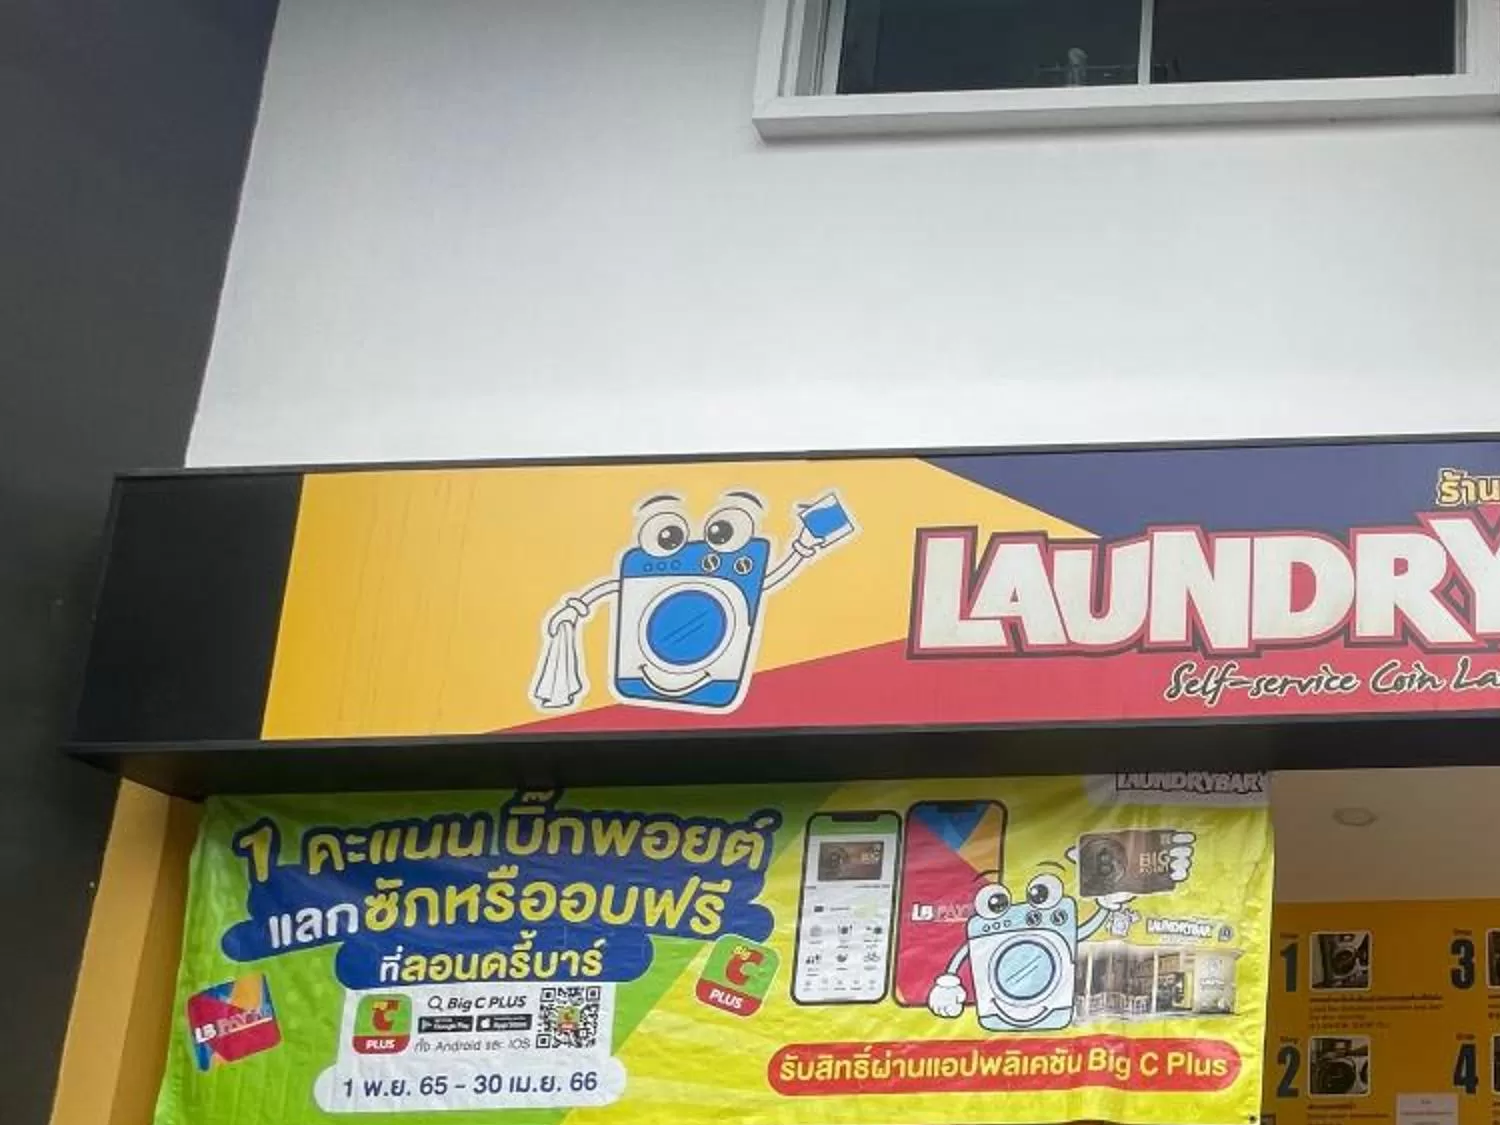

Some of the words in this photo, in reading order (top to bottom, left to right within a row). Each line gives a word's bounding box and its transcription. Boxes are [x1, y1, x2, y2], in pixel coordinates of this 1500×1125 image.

[1166, 660, 1359, 702] Self-service
[1371, 655, 1445, 694] Coin
[239, 825, 273, 883] 1
[306, 819, 486, 876] คะแนน
[504, 790, 775, 872] บิ๊กพอยต์
[1278, 941, 1298, 993] 1
[1450, 938, 1477, 990] 3
[447, 997, 473, 1012] Big
[475, 997, 486, 1009] C
[488, 995, 527, 1009] PLUS
[708, 988, 743, 1010] PLUS
[364, 1040, 396, 1050] PLUS
[1088, 1047, 1132, 1078] Big
[1139, 1054, 1159, 1076] C
[1166, 1052, 1228, 1078] Plus
[363, 1078, 412, 1098] พ.ย.
[419, 1076, 448, 1096] 65
[473, 1075, 503, 1095] 30
[569, 1072, 599, 1093] 66
[1275, 1045, 1301, 1098] 2
[1452, 1043, 1479, 1095] 4
